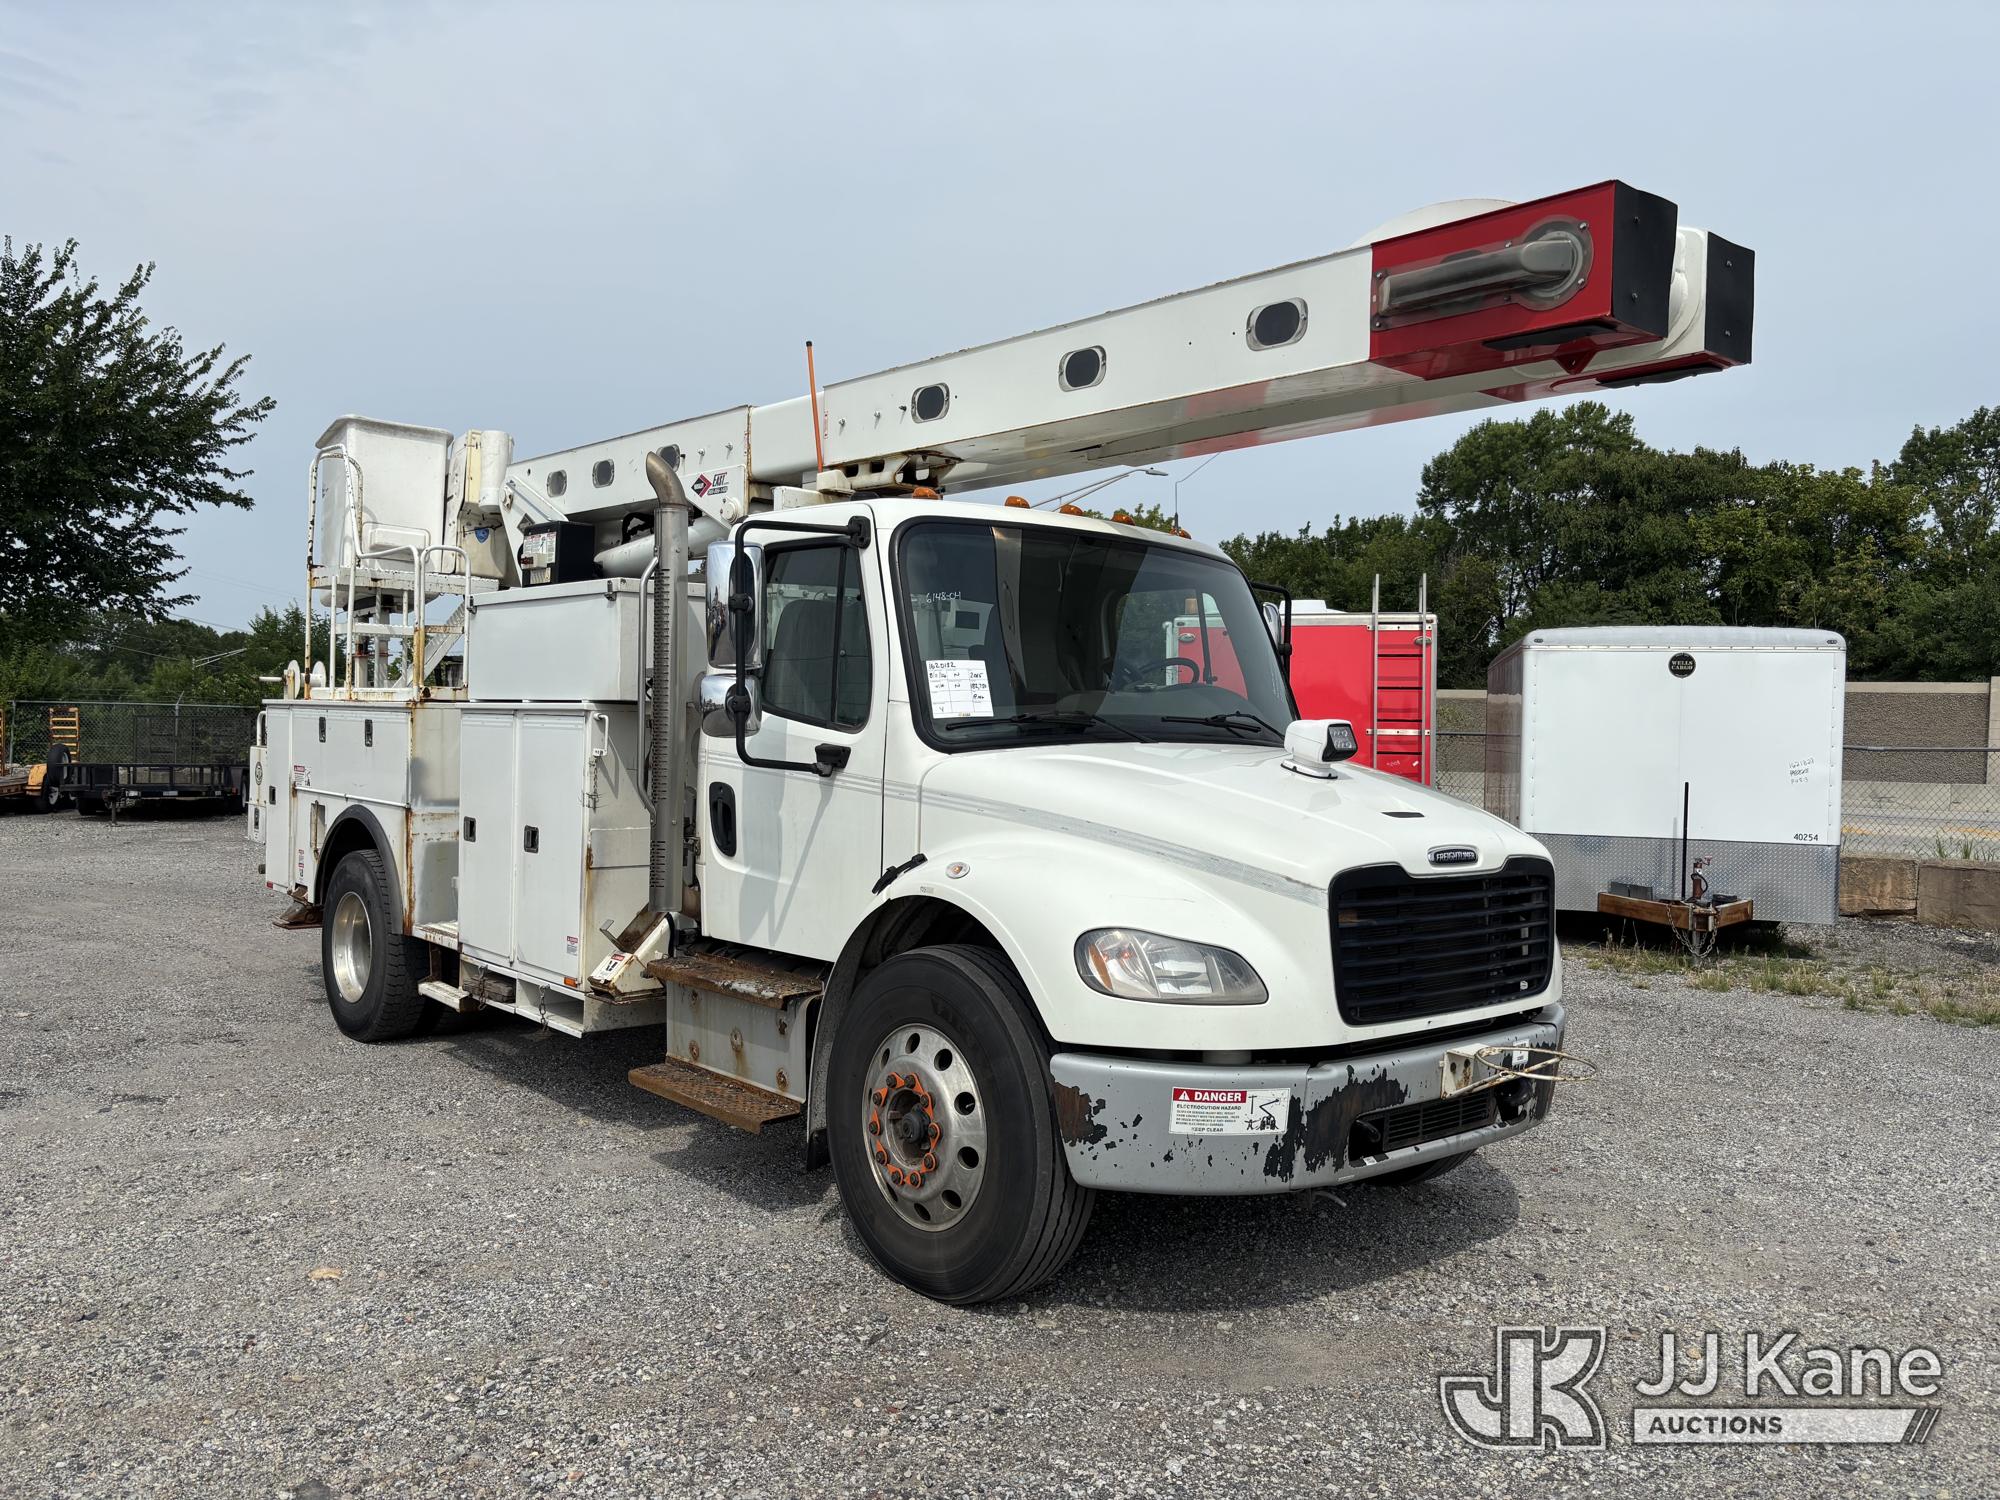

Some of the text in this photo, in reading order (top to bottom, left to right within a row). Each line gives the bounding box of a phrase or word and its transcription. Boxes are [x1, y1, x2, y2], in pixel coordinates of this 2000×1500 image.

[712, 472, 727, 487] EAST
[1793, 833, 1819, 842] 40254
[1436, 851, 1475, 862] FREIGHTLINER
[1194, 1091, 1242, 1102] DANGER
[1176, 1103, 1220, 1111] ELECTROCUTION
